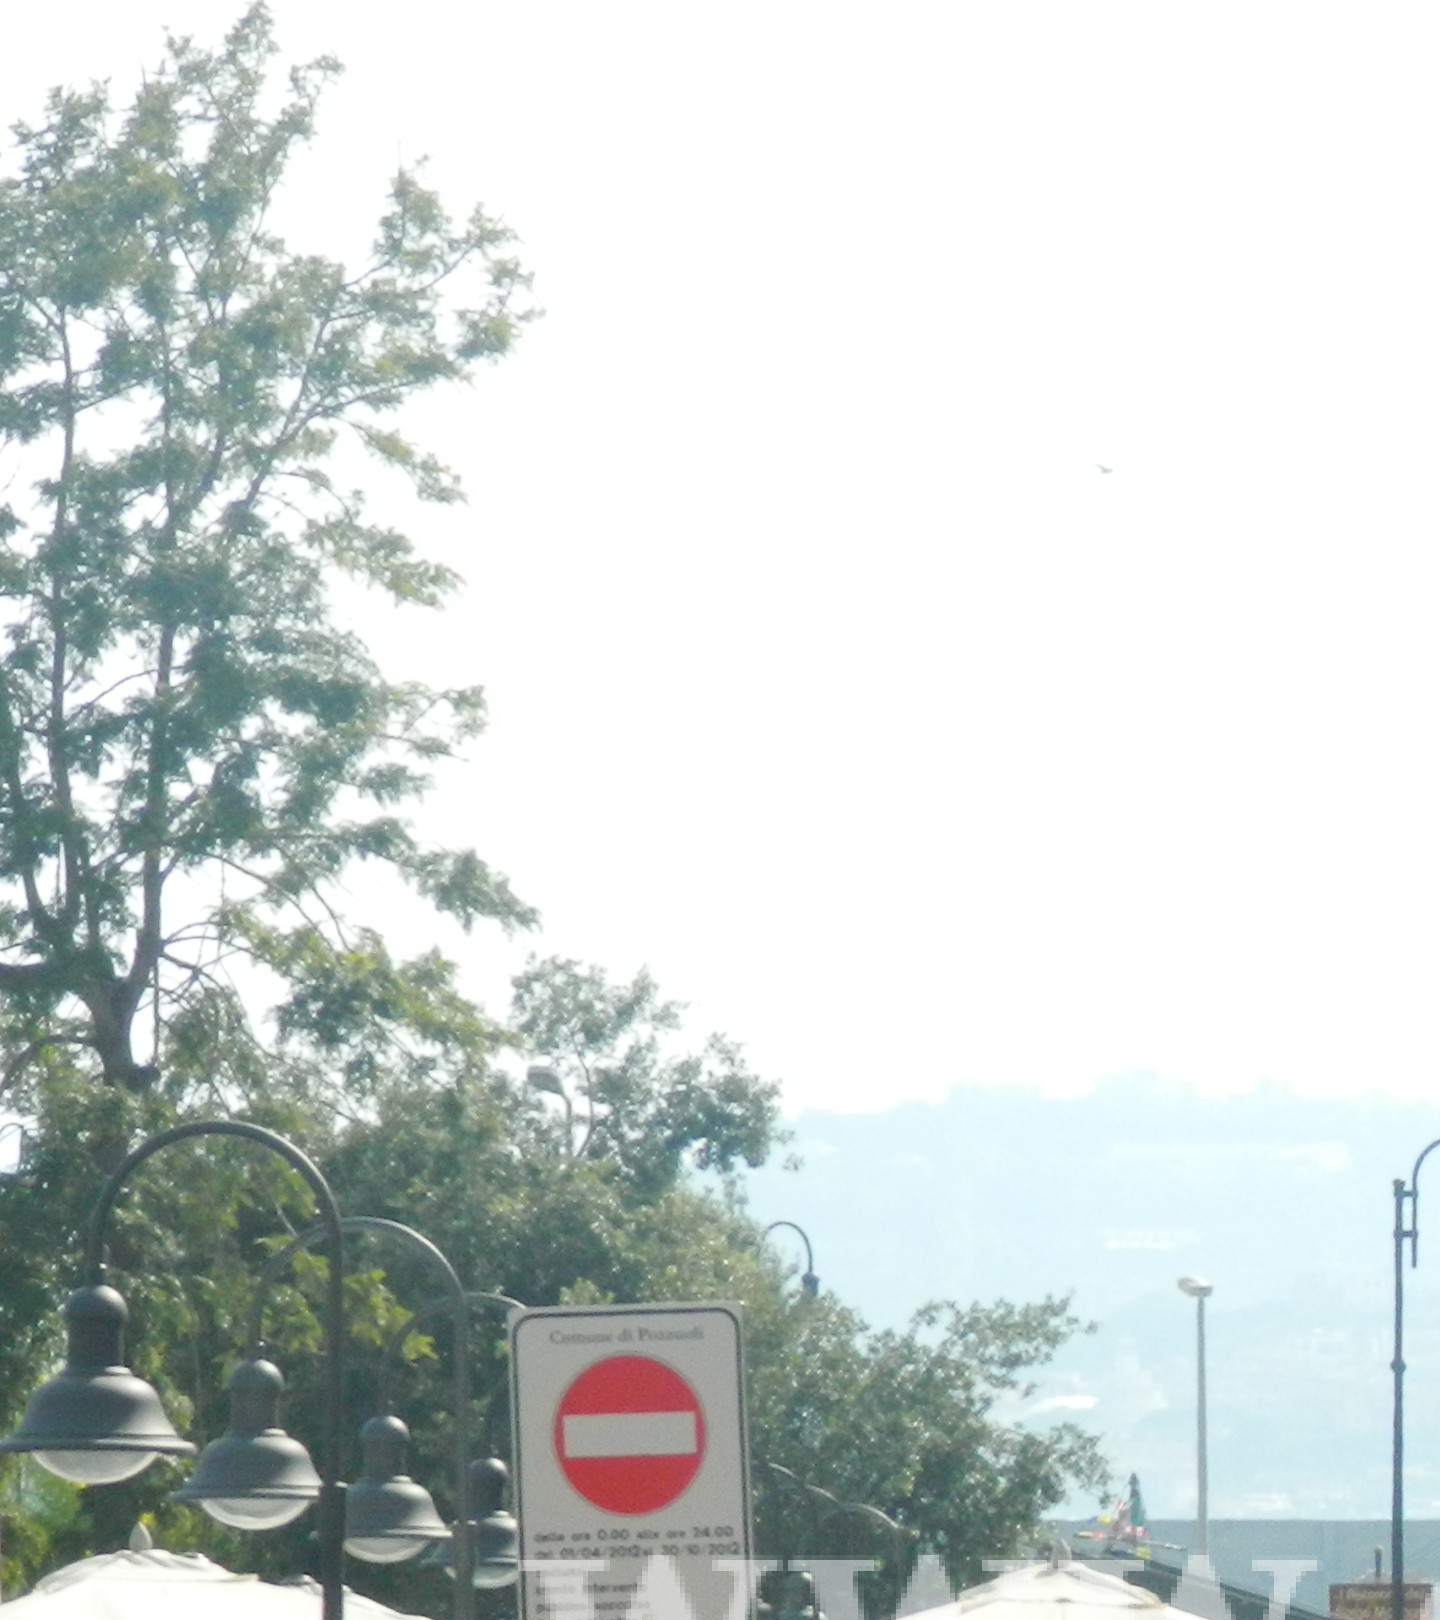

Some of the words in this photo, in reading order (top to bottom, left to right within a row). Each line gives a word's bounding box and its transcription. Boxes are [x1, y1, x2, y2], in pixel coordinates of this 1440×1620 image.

[549, 1329, 612, 1345] Comune
[617, 1327, 633, 1342] di
[638, 1325, 704, 1342] Pozzuoli
[597, 1528, 630, 1541] 0.00
[692, 1525, 735, 1539] 24.00
